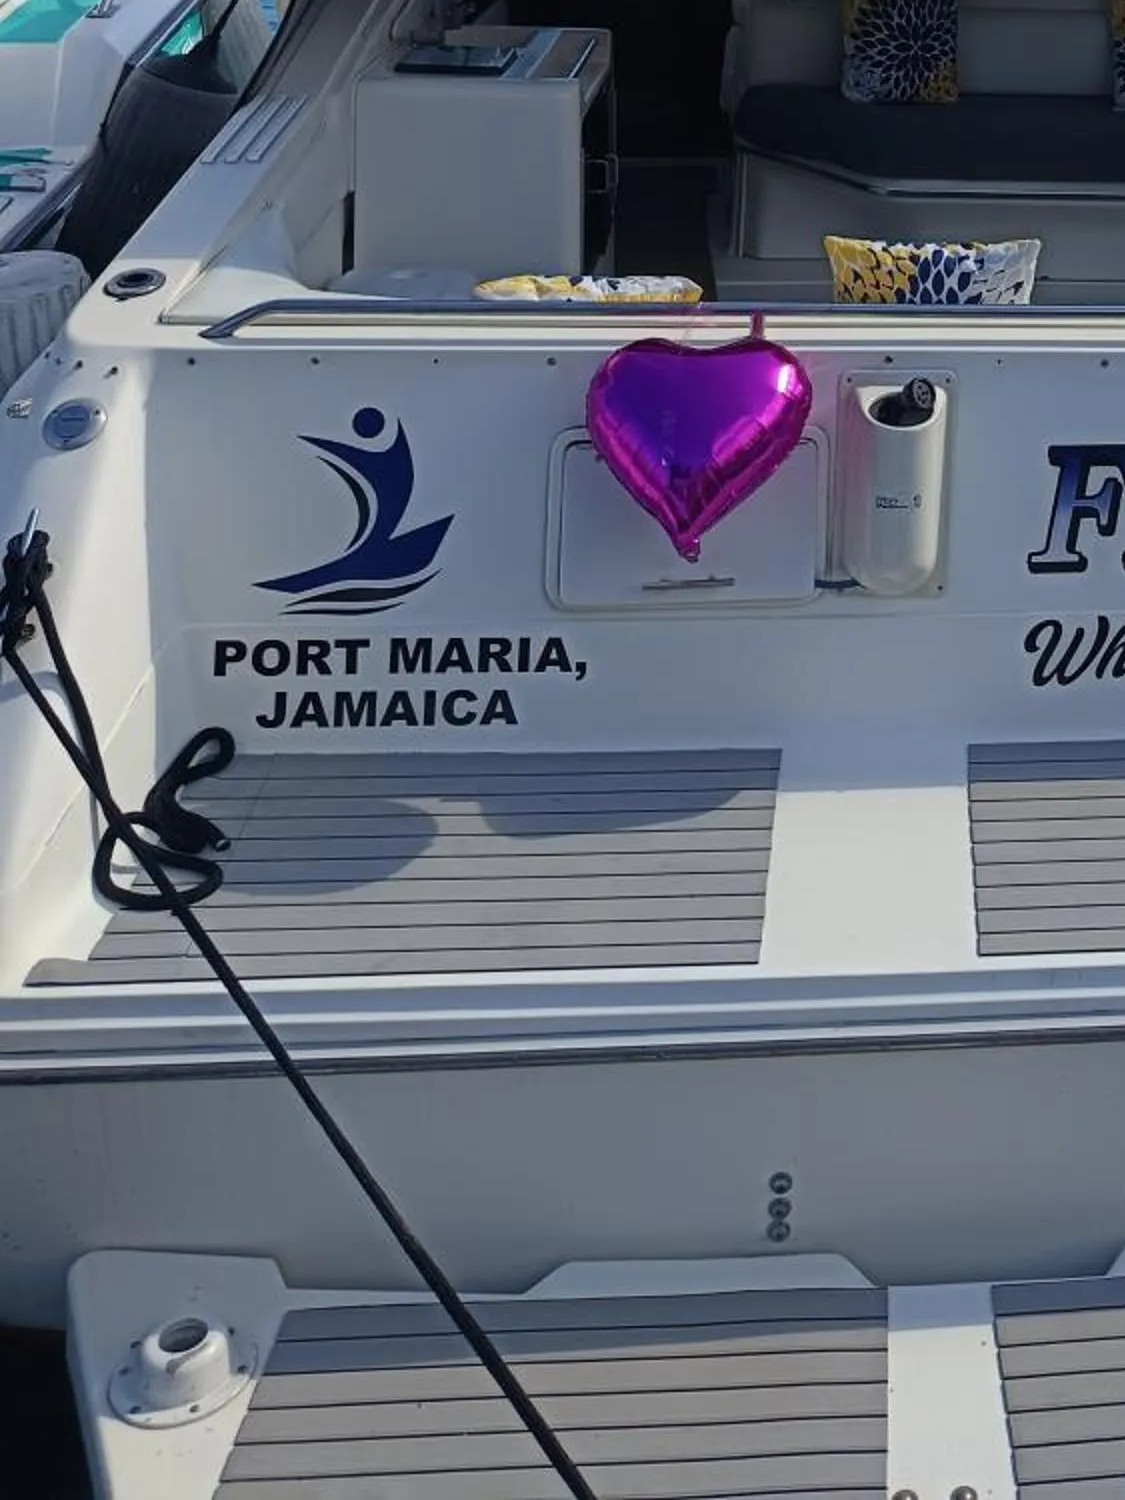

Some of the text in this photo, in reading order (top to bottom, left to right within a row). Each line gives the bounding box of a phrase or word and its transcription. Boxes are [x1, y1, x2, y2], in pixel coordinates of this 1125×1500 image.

[212, 637, 588, 682] PORT MARIA,
[255, 688, 519, 730] JAMAICA
